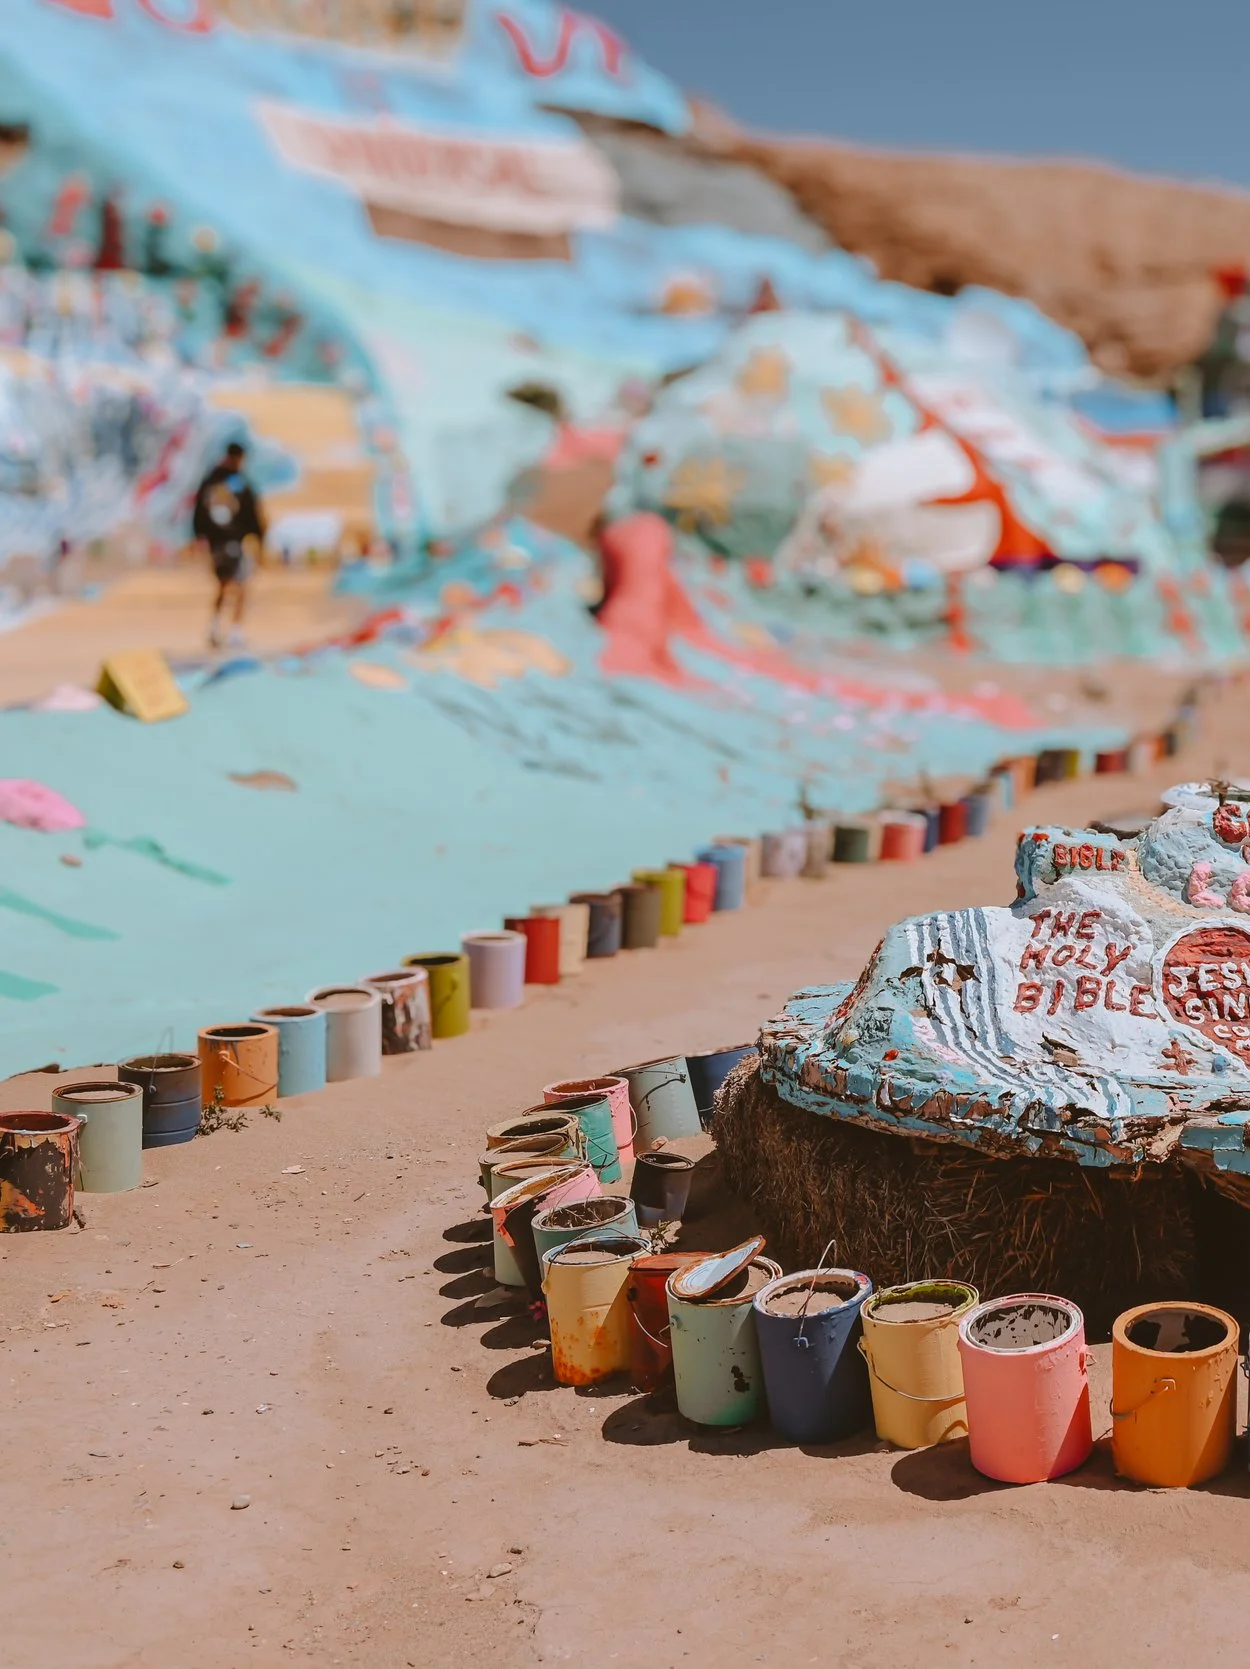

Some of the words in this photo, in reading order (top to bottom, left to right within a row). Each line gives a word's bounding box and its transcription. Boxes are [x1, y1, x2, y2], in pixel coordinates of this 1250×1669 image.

[1028, 908, 1103, 940] THE
[1019, 942, 1133, 977] HOLY
[1012, 975, 1158, 1020] BIBLE
